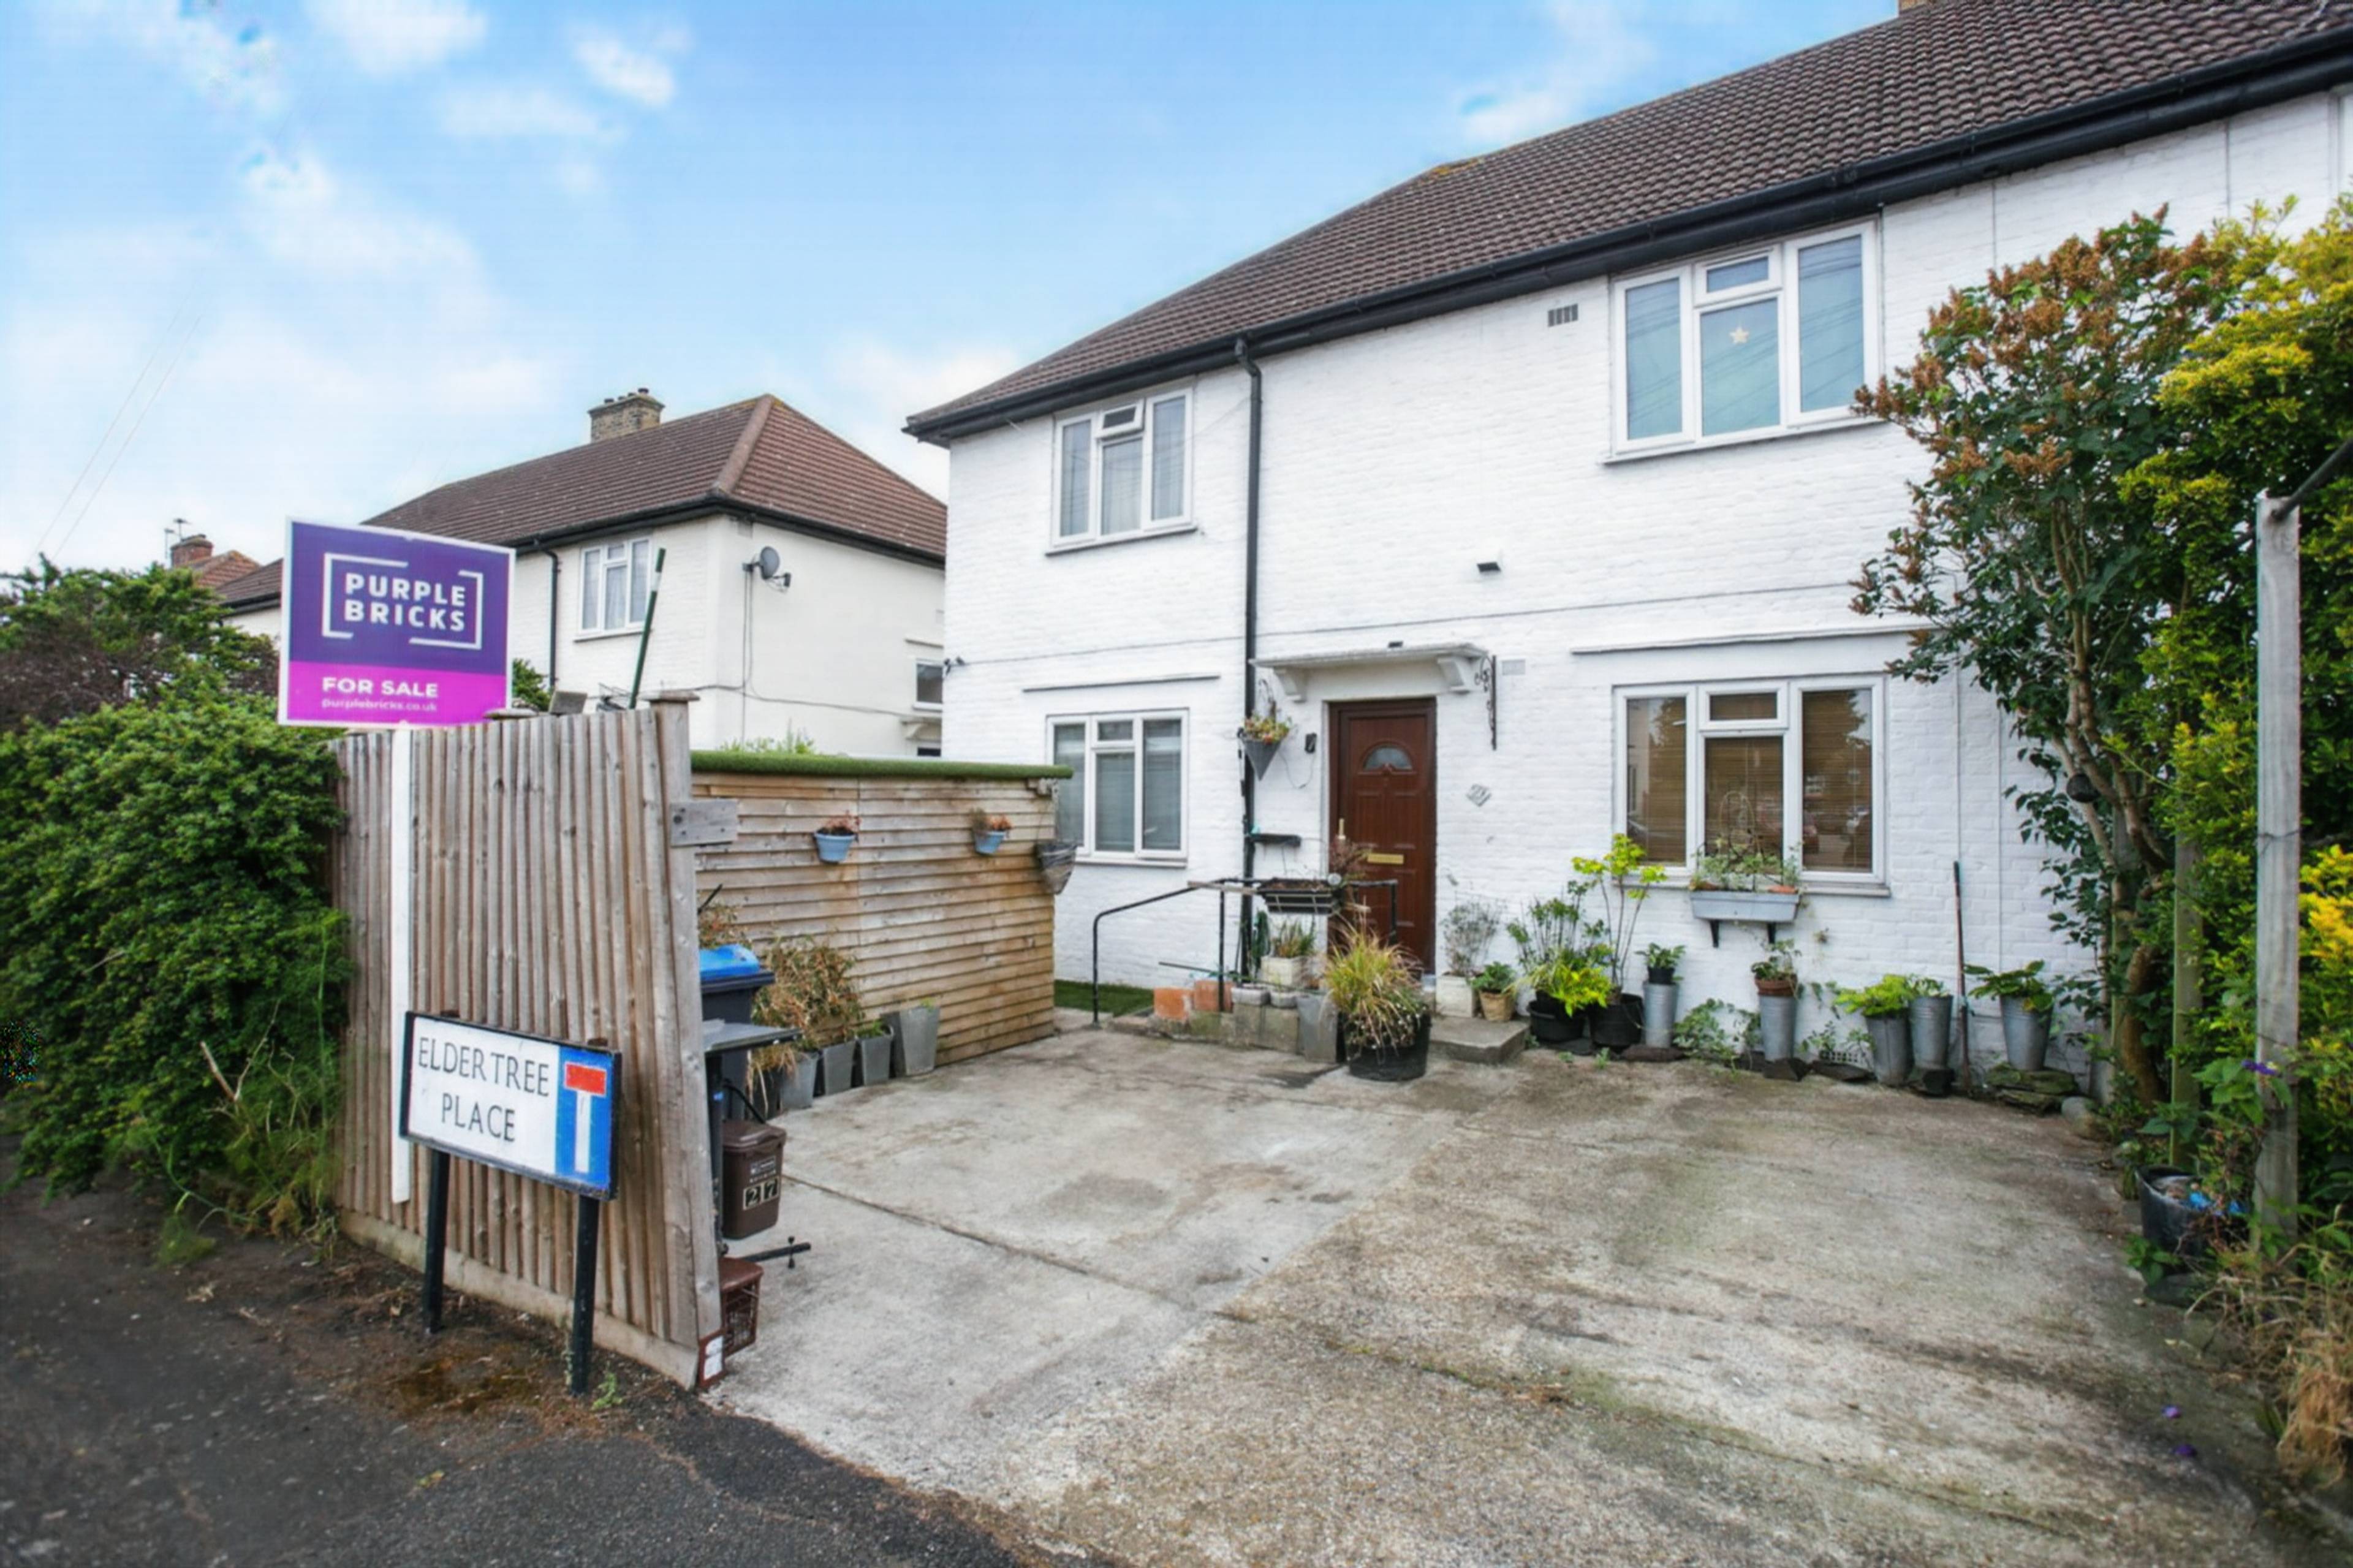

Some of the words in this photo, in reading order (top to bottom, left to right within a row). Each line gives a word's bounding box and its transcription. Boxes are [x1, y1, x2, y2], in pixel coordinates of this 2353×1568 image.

[346, 572, 465, 607] PURPLE
[344, 599, 464, 631] BRICKS
[322, 677, 373, 694] FOR
[381, 680, 438, 698] SALE
[322, 698, 437, 711] purplebricks.co.uk
[442, 1093, 515, 1142] PLACE
[746, 1180, 777, 1207] 27
